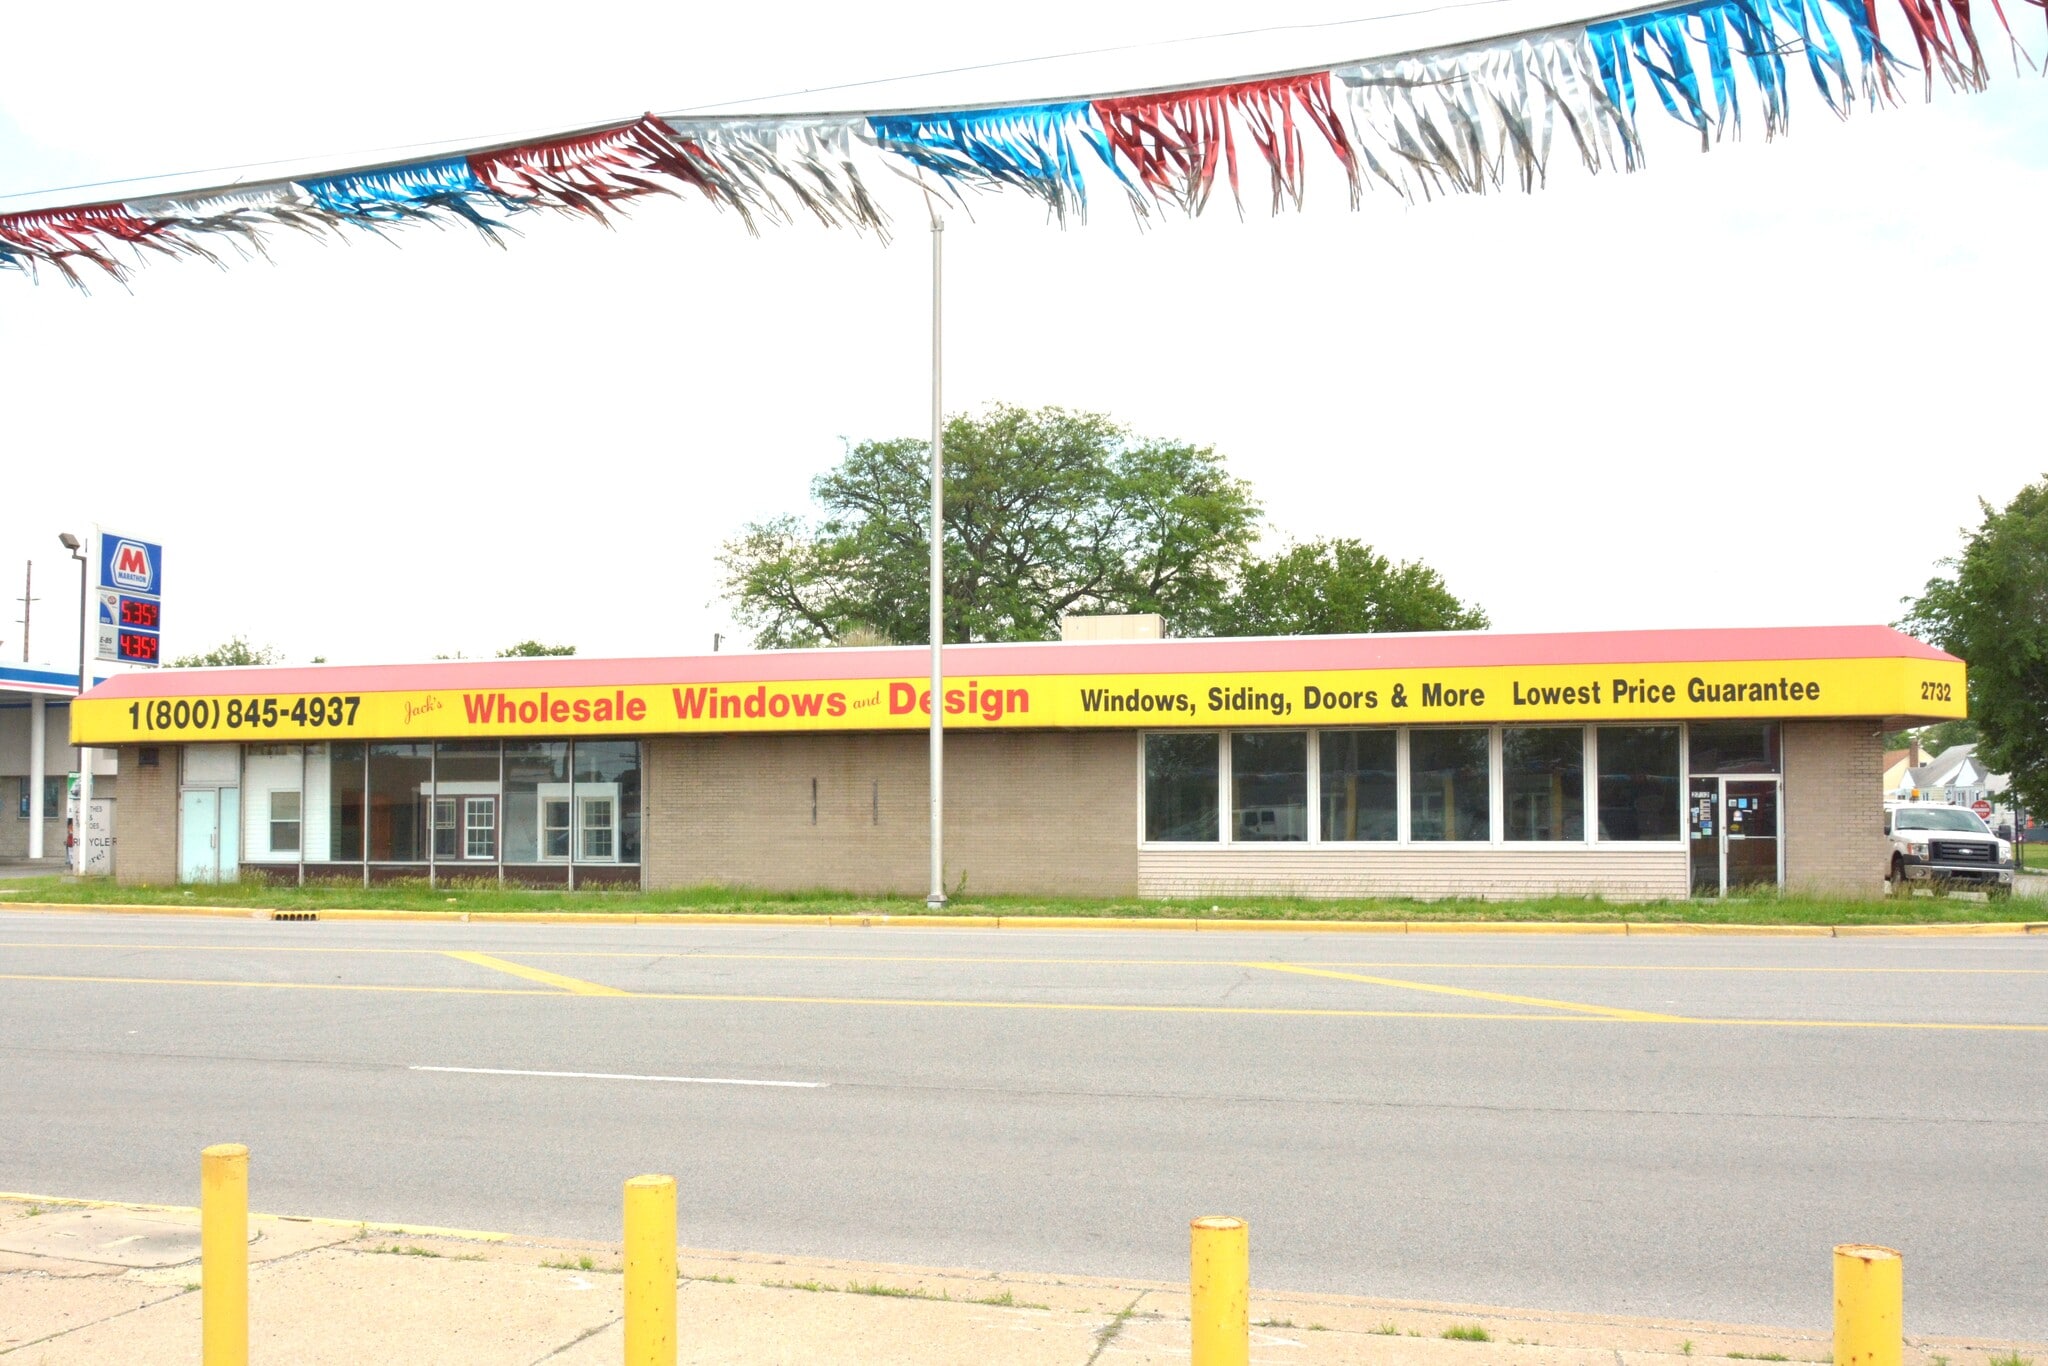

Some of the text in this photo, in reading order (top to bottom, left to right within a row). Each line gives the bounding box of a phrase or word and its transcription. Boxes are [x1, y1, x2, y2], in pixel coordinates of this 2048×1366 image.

[119, 548, 146, 575] M
[118, 571, 146, 583] MARATHON
[404, 681, 1029, 725] Jack's Wholesale Windows and Design
[1081, 677, 1820, 716] Windows, Siding, Doors & More Lowest Price Guarantee
[1921, 681, 1951, 702] 2732
